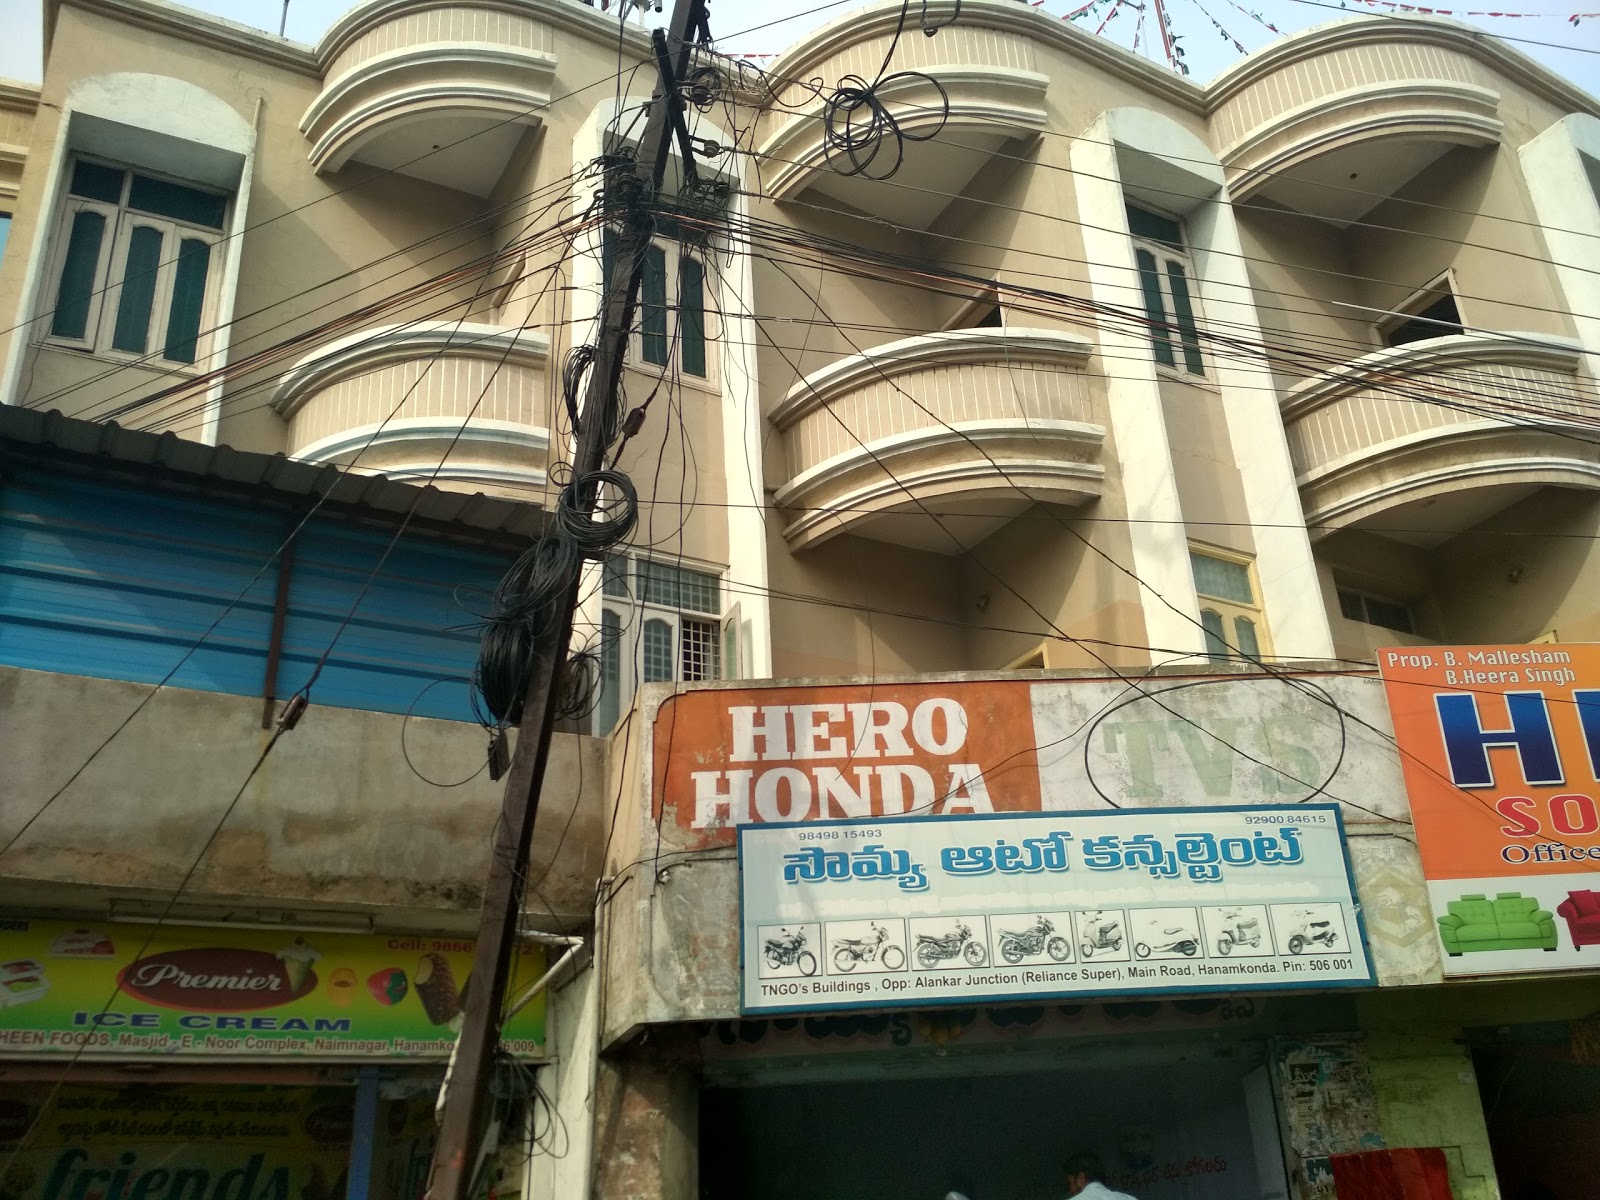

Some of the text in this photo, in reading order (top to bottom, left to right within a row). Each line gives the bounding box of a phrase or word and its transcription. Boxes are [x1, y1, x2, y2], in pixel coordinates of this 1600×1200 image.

[1387, 649, 1571, 669] Prop. B. Mallesham
[1445, 667, 1576, 686] B.Heera Singh
[727, 698, 968, 762] HERO
[1101, 715, 1321, 800] TVS
[690, 763, 995, 829] HONDA
[1244, 814, 1326, 825] 92900 84615
[799, 829, 882, 841] 98498 15493
[939, 830, 1073, 874] ఆటో
[387, 939, 425, 951] Cell:
[130, 963, 281, 991] Premier
[761, 983, 809, 996] TNGO's
[812, 980, 871, 994] Buildings
[881, 978, 911, 991] Opp:
[915, 976, 961, 988] Alankar
[965, 973, 1018, 986] Junction
[1021, 970, 1077, 985] (Reliance
[1081, 967, 1125, 981] Super),
[1128, 966, 1156, 978] Main
[1160, 963, 1194, 977] Road,
[1198, 962, 1280, 976] Hanamkonda.
[1283, 960, 1306, 972] Pin:
[1309, 959, 1330, 971] 506
[1333, 958, 1353, 971] 001
[73, 1012, 351, 1031] ICE CREAM
[120, 1033, 168, 1049] Masjid
[205, 1037, 242, 1050] Noor
[244, 1037, 310, 1052] Complex,
[314, 1039, 391, 1053] Naimnagar,
[394, 1041, 456, 1054] Hanamko
[513, 1040, 535, 1053] 009
